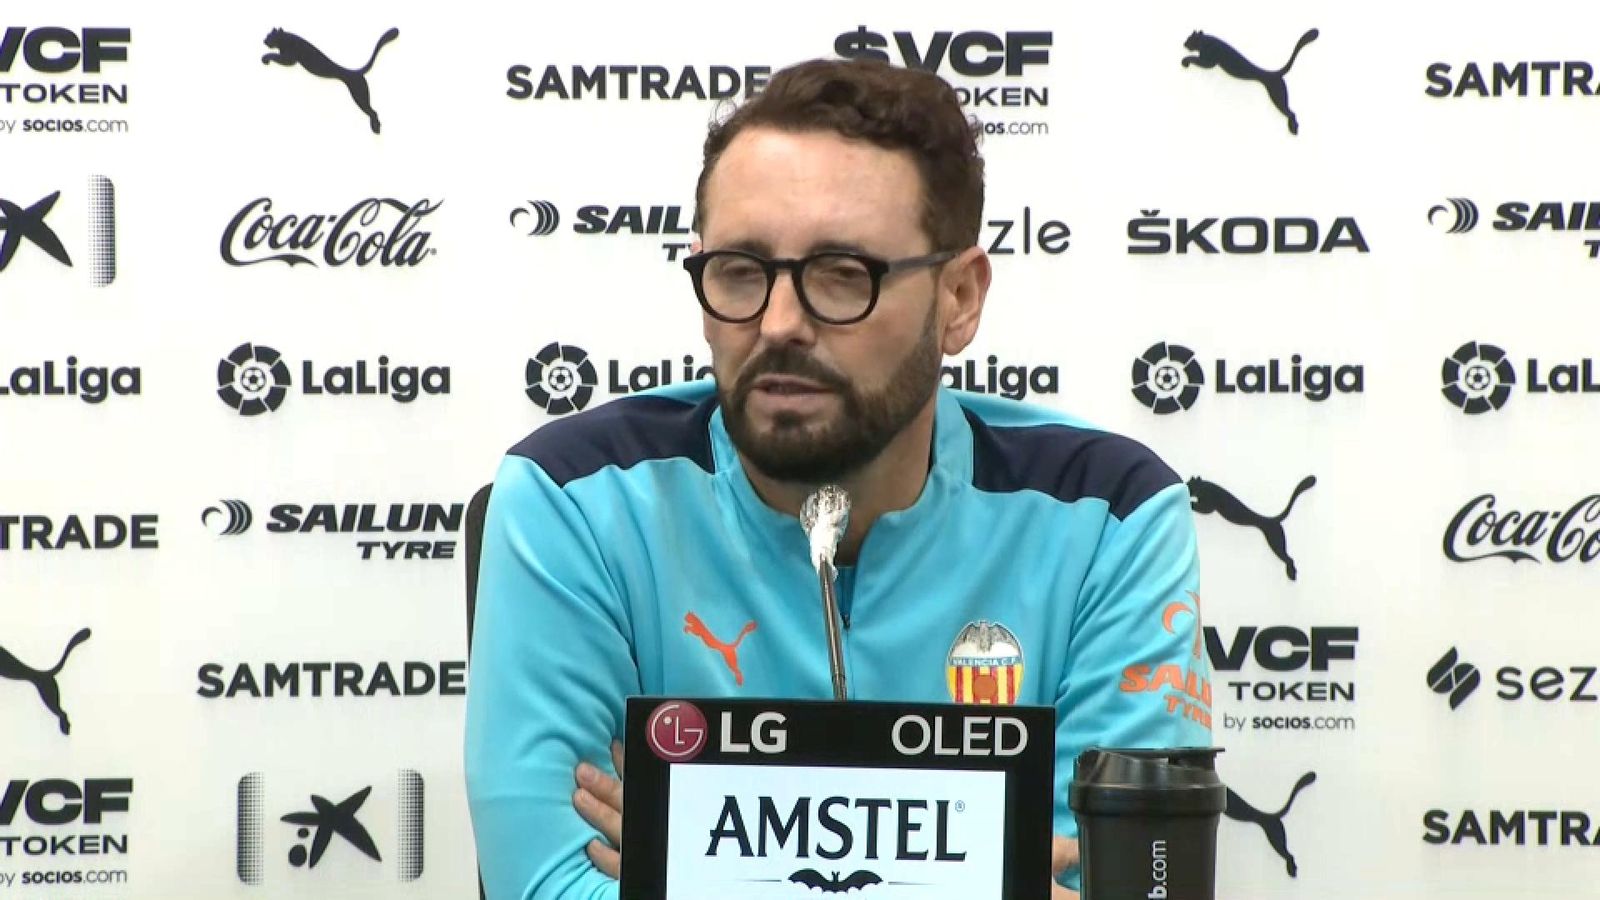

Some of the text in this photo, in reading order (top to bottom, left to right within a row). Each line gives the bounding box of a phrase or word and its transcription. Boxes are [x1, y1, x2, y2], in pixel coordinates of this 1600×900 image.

[0, 83, 128, 104] TOKEN
[506, 64, 771, 100] SAMTRADE
[954, 86, 1049, 107] OKEN
[1425, 61, 1600, 98] SAMTR
[22, 118, 129, 133] socios.com
[219, 197, 444, 267] Coca-Cola
[573, 204, 697, 235] SAIL
[987, 205, 1071, 255] zle
[1127, 209, 1370, 255] ŠKODA
[0, 355, 141, 404] aLiga
[302, 354, 451, 404] LaLiga
[940, 354, 1059, 401] aLiga
[1215, 354, 1364, 403] LaLiga
[0, 514, 159, 551] TRADE
[266, 503, 465, 533] SAILUN
[356, 541, 457, 561] TYRE
[196, 661, 466, 699] SAMTRADE
[1227, 681, 1355, 702] TOKEN
[720, 711, 788, 754] LG
[891, 714, 1029, 756] OLED
[1223, 712, 1356, 733] by socios.com
[0, 834, 128, 856] TOKEN
[705, 794, 967, 862] AMSTEL
[1422, 809, 1600, 846] SAMTR
[21, 869, 128, 884] socios.com
